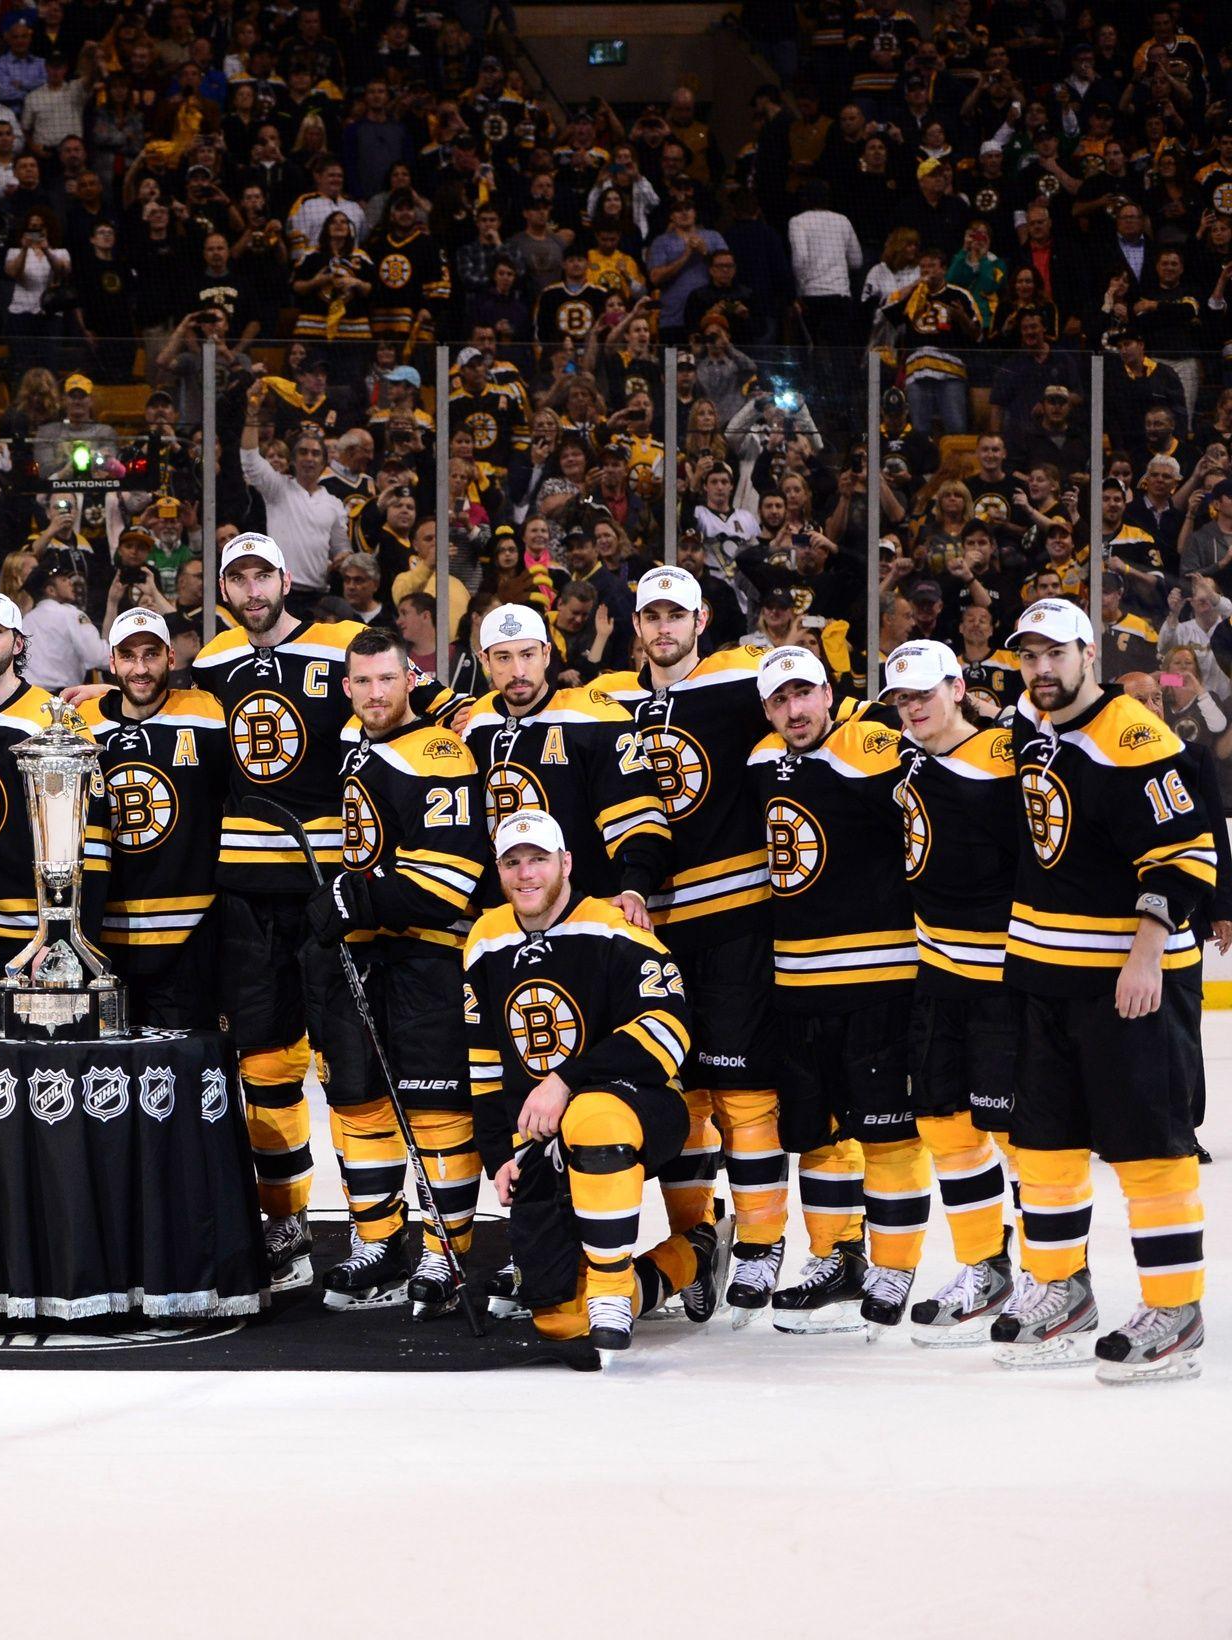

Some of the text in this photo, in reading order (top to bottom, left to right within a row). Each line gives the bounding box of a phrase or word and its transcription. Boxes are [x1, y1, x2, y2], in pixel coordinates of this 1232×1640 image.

[52, 479, 121, 489] DAKTRONICS
[303, 661, 329, 698] C
[992, 670, 1005, 691] C
[172, 728, 199, 767] A
[245, 711, 282, 764] B
[427, 738, 458, 752] BRUINS
[540, 725, 569, 765] A
[647, 748, 685, 801] B
[113, 782, 154, 835] B
[424, 786, 470, 828] 21
[1144, 769, 1194, 825] 16
[344, 797, 361, 848] B
[1024, 786, 1052, 848] B
[771, 819, 800, 874] B
[639, 959, 686, 1003] 22
[520, 1002, 561, 1059] B
[698, 1052, 746, 1068] Reebok
[40, 1083, 62, 1107] NHL
[93, 1082, 117, 1105] NHL
[149, 1082, 169, 1106] NHL
[397, 1078, 459, 1091] BAUER
[863, 1111, 914, 1126] BAUE
